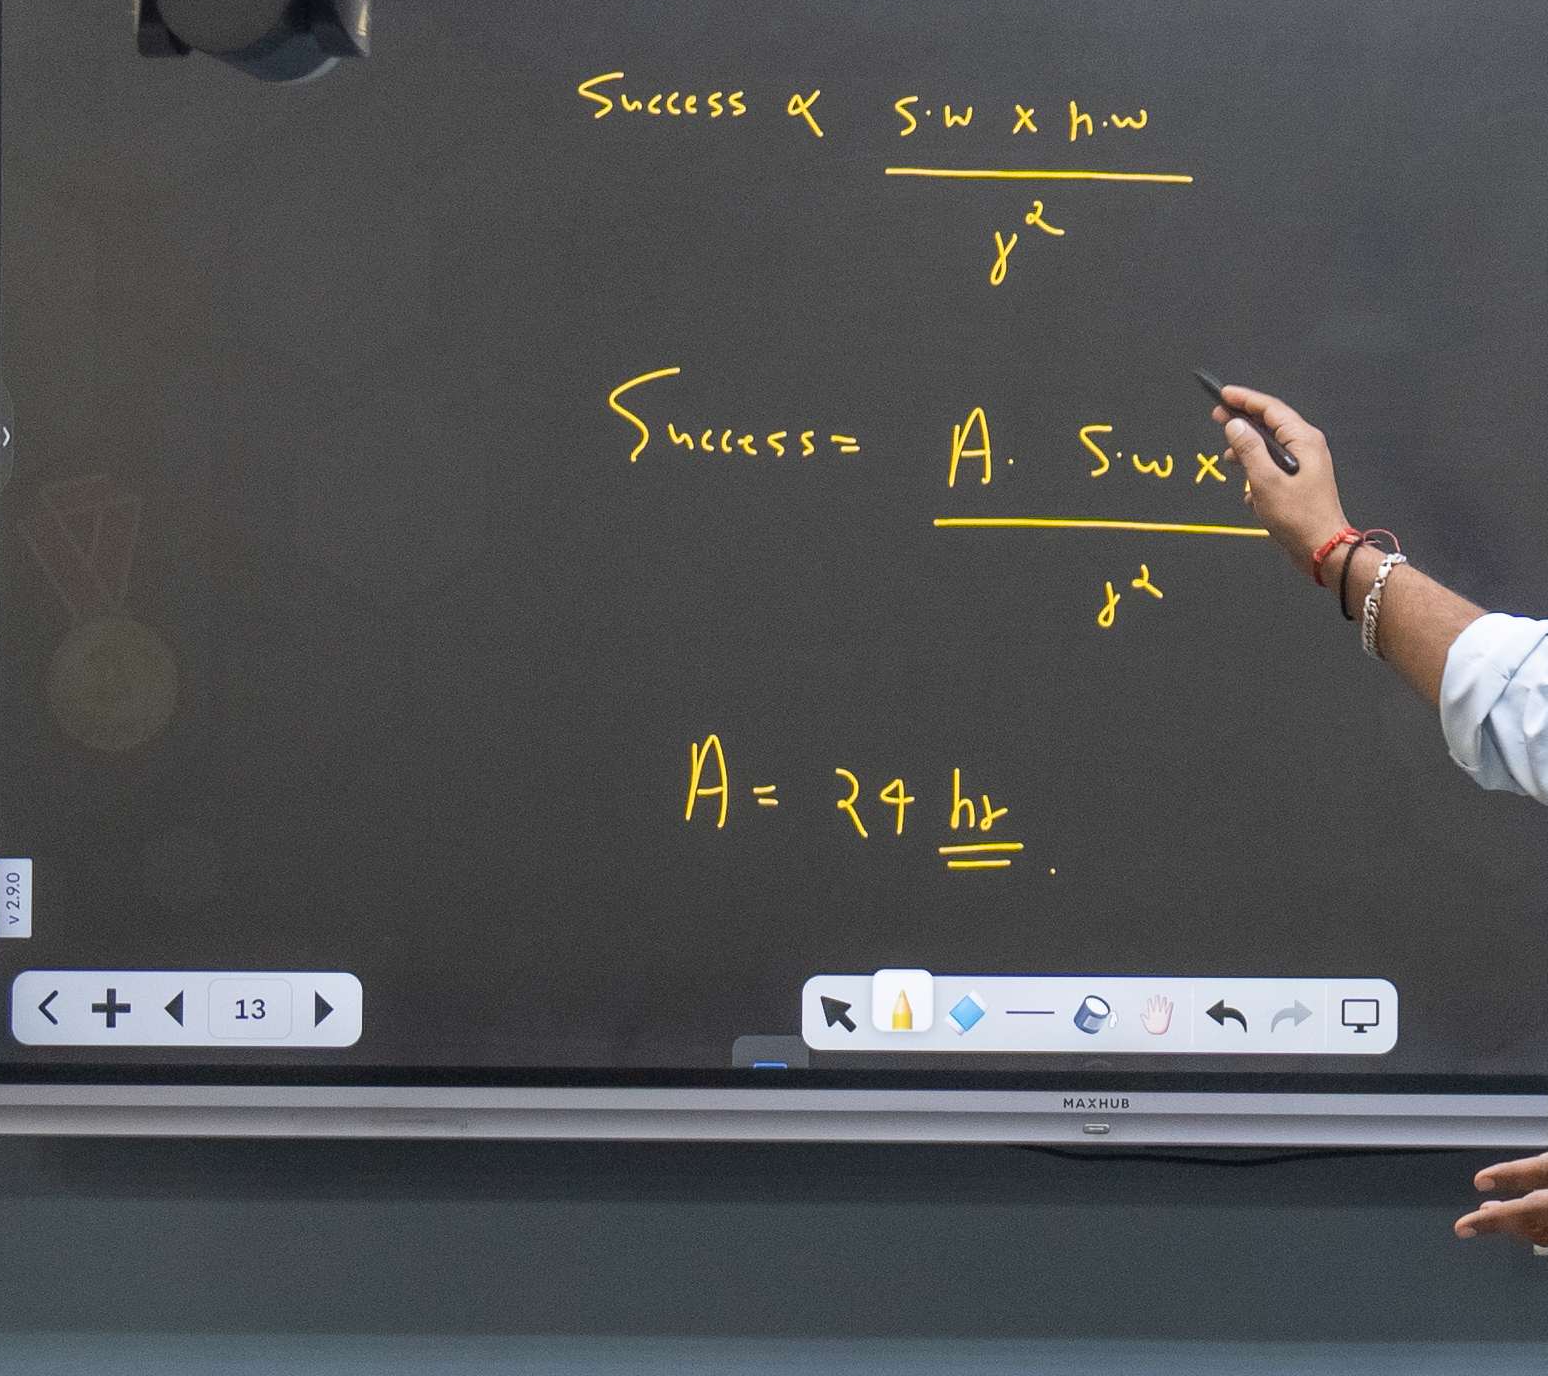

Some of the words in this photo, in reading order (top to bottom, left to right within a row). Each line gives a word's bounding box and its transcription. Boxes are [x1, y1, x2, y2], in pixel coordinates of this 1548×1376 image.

[577, 70, 748, 119] Success
[835, 767, 916, 839] 24
[5, 871, 22, 910] 2.9.0
[233, 997, 267, 1021] 13
[1062, 1097, 1131, 1110] MAXHUB
